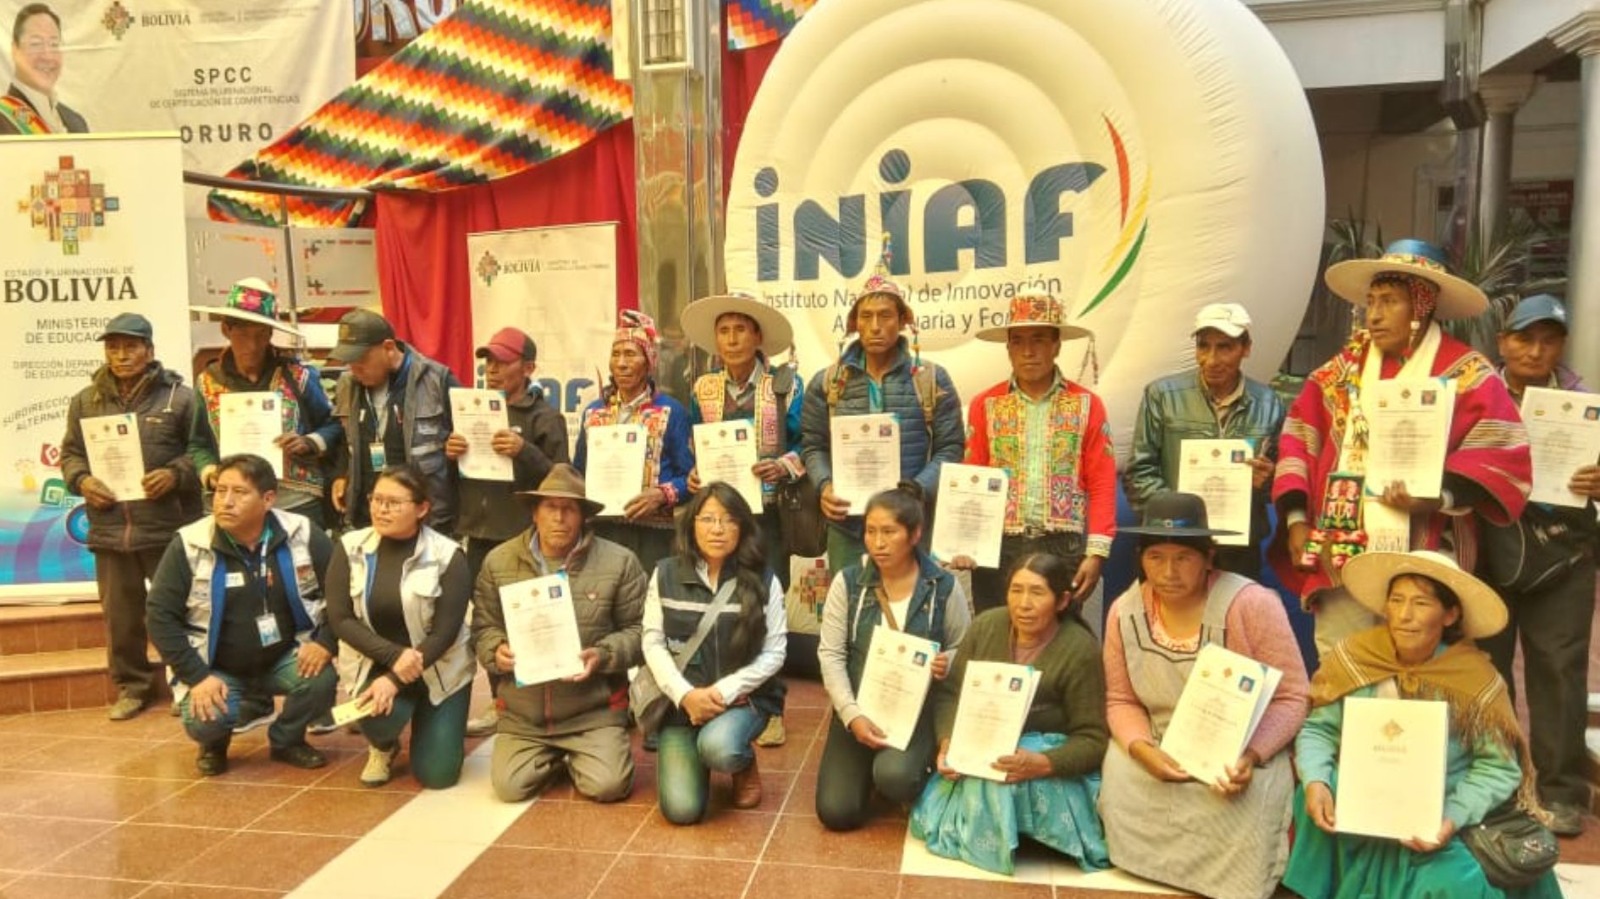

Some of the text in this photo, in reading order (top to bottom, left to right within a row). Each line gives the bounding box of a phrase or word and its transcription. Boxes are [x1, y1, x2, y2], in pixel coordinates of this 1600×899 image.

[141, 14, 191, 27] BOLIVIA
[193, 67, 252, 85] SPCC
[180, 123, 273, 144] ORURO
[3, 276, 139, 303] BOLIVIA
[918, 282, 942, 303] de
[962, 313, 973, 334] y
[25, 332, 43, 343] DE
